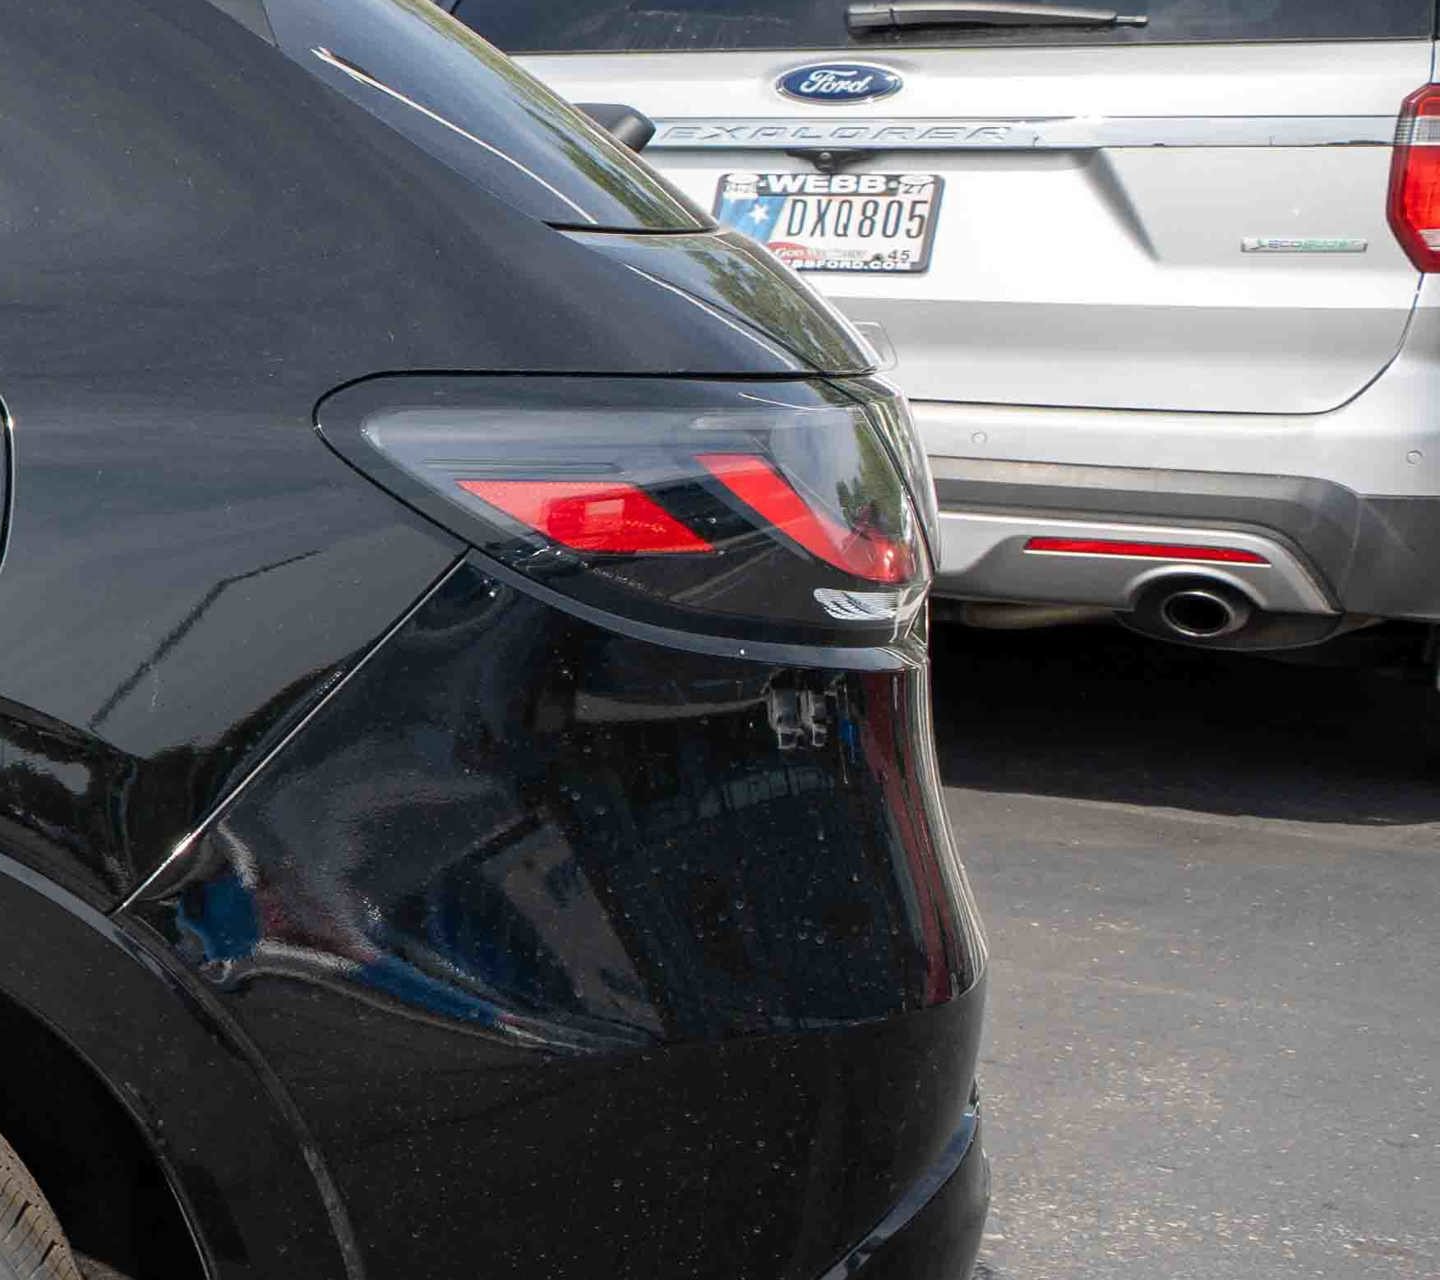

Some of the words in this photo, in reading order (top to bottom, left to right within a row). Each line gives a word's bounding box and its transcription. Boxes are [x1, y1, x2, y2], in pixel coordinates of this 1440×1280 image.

[799, 69, 871, 94] Ford
[660, 125, 1012, 141] EXPLORER
[765, 175, 888, 195] WEBB
[786, 197, 929, 240] DXQ805
